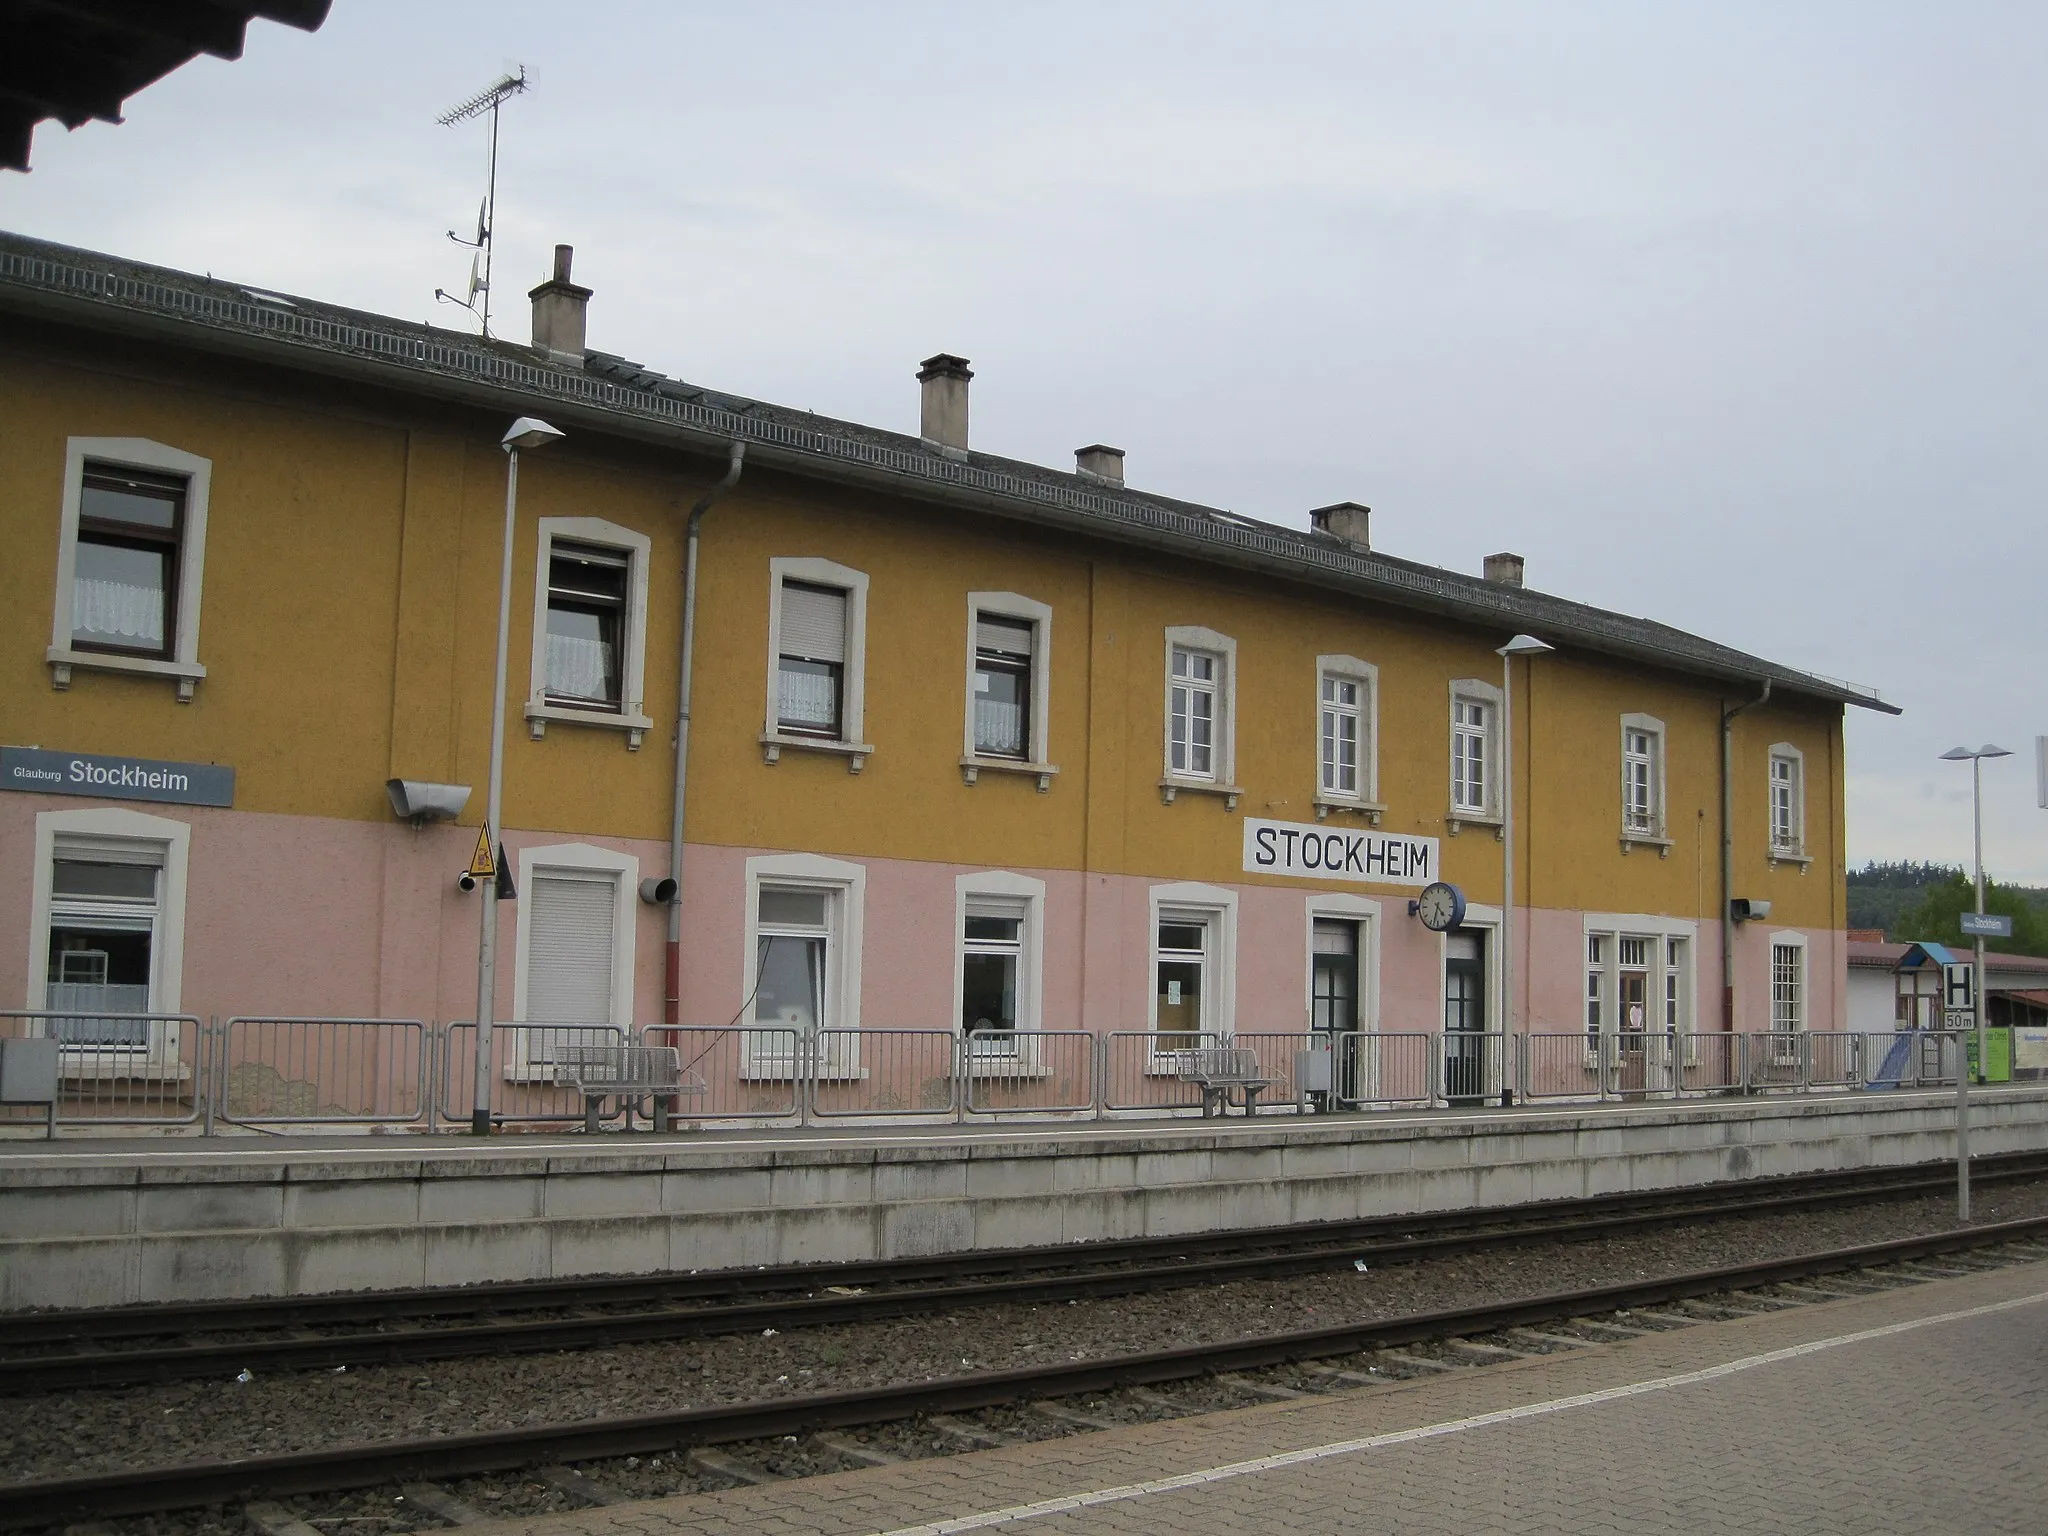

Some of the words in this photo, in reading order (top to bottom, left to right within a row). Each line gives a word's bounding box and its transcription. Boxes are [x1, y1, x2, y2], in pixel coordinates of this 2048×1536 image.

[14, 766, 62, 783] Glauburg
[69, 760, 188, 791] Stockheim
[1255, 827, 1428, 878] STOCKHEIM
[1946, 966, 1970, 1006] H
